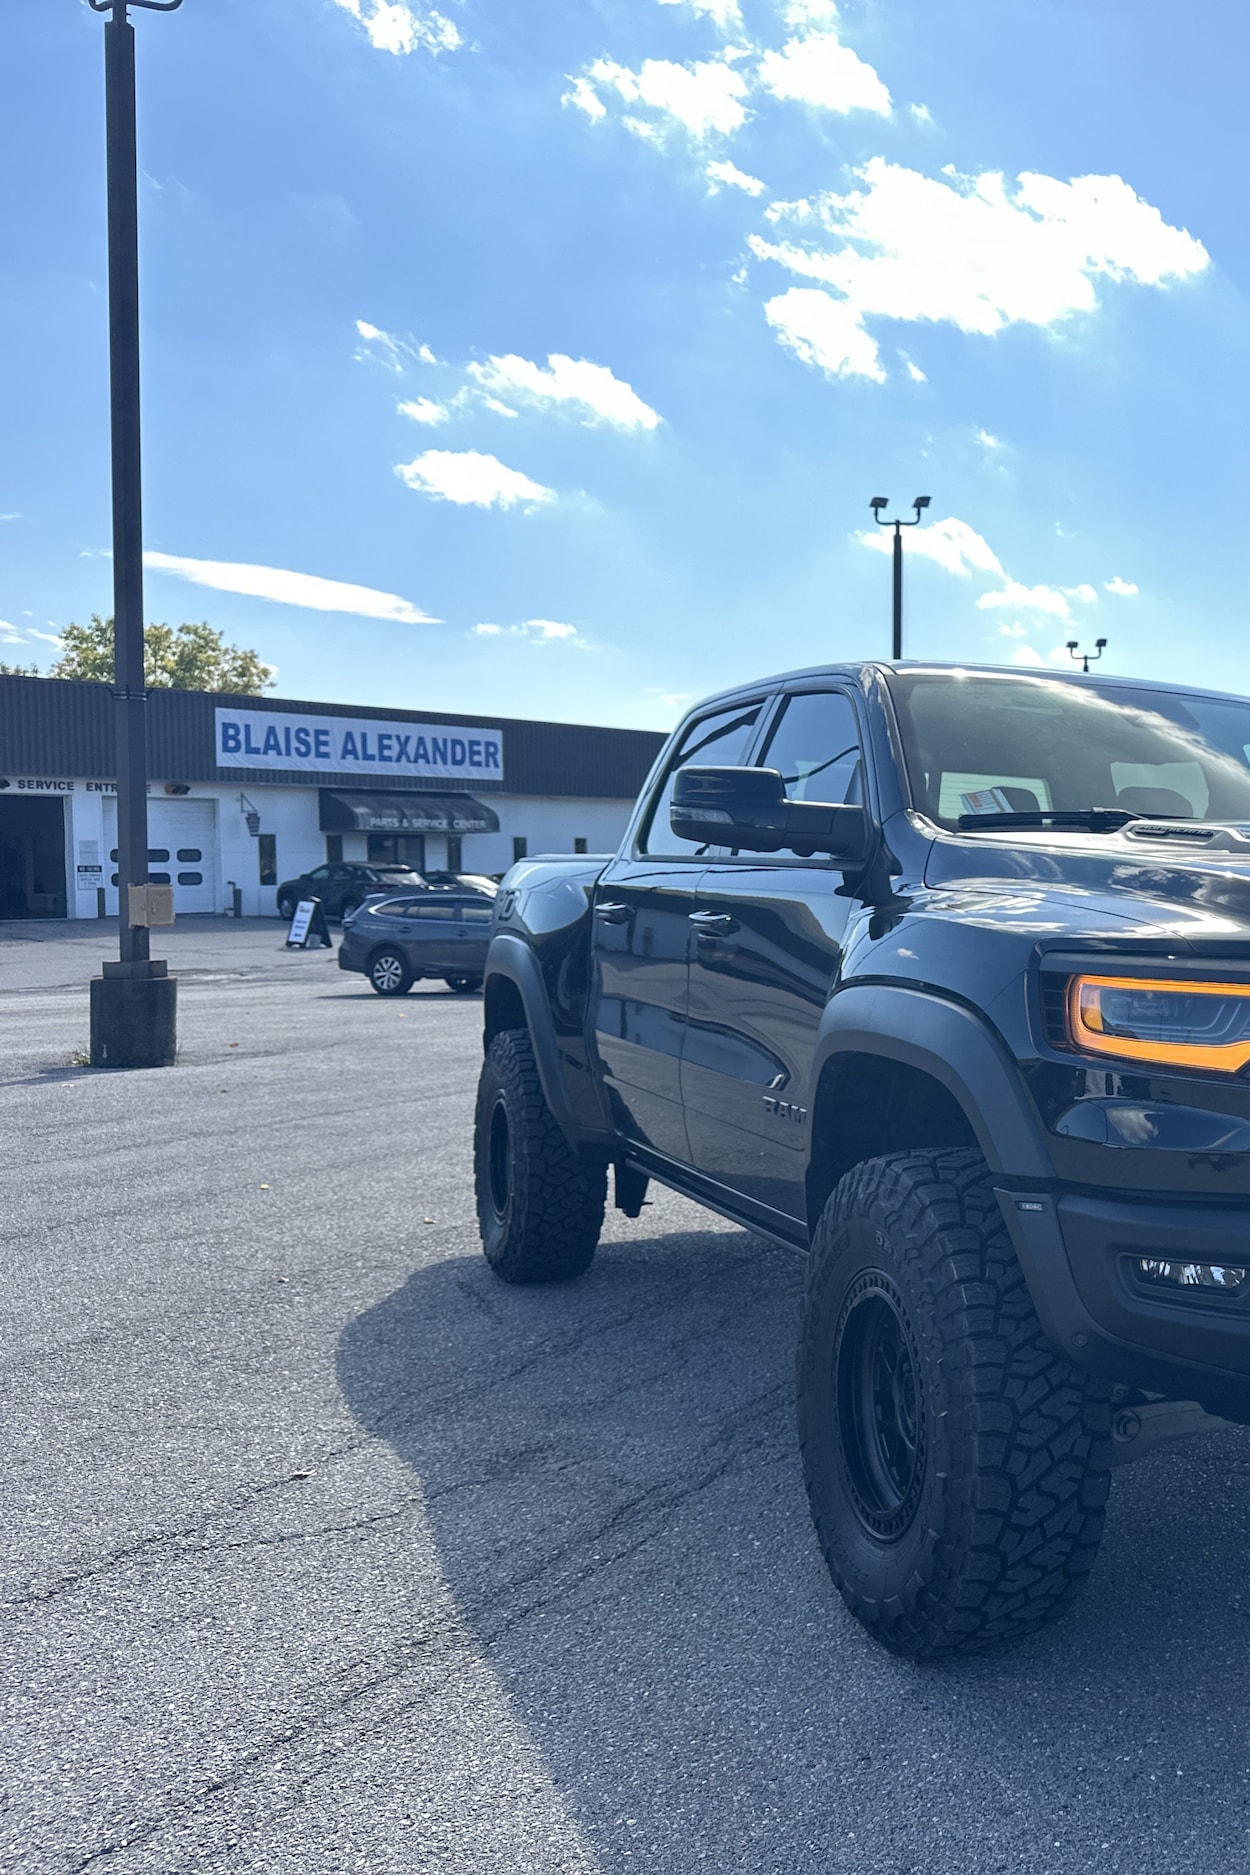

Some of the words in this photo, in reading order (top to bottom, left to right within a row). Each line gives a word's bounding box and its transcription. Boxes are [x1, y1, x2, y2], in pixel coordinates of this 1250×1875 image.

[221, 722, 331, 759] BLAISE
[340, 731, 500, 769] ALEXANDER
[17, 779, 75, 791] SERVICE
[86, 782, 152, 794] ENTRE
[369, 817, 399, 827] PARTS
[402, 817, 409, 828] &
[412, 817, 449, 829] SERVICE
[453, 819, 487, 829] CENTER
[762, 1095, 808, 1125] RAM
